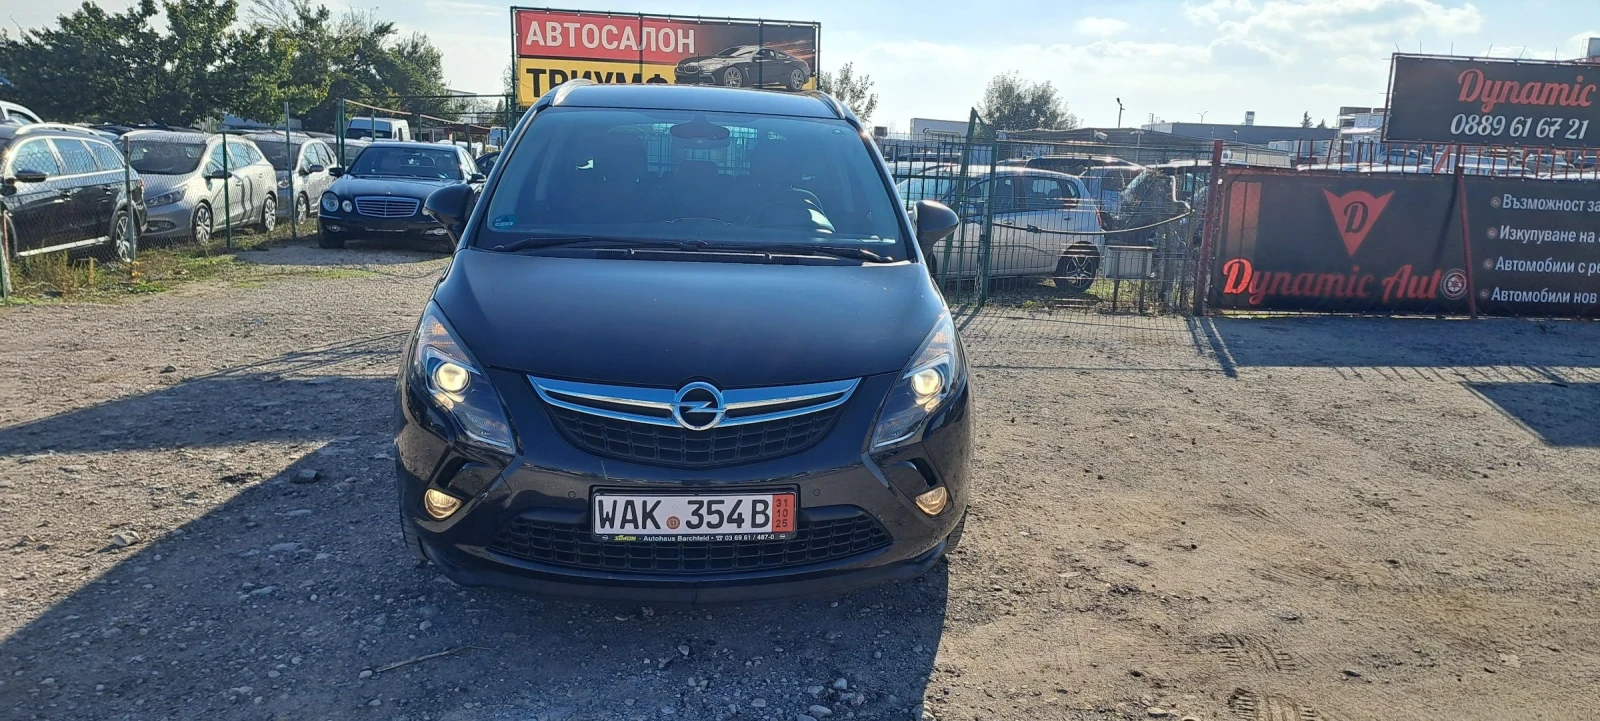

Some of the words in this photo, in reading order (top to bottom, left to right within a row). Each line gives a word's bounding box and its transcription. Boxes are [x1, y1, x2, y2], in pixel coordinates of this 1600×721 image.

[525, 20, 695, 54] АВТОСАЛОН
[1457, 68, 1597, 113] Dynamic
[1450, 113, 1506, 137] 0889
[1509, 116, 1533, 138] 61
[1536, 117, 1564, 139] 67
[1564, 118, 1590, 140] 21
[1502, 193, 1586, 212] Възможност
[1587, 200, 1600, 212] за
[1343, 201, 1369, 234] D
[1499, 224, 1577, 245] Изкупуване
[1579, 230, 1596, 243] на
[1495, 256, 1575, 273] Автомобили
[1578, 262, 1586, 274] с
[1222, 257, 1375, 306] Dynamic
[1491, 286, 1571, 304] Автомобили
[1573, 291, 1598, 304] нов
[775, 498, 788, 508] 31
[597, 499, 662, 530] WAK
[775, 509, 789, 518] 10
[775, 518, 789, 528] 25
[613, 534, 637, 542] SIMON
[677, 534, 710, 542] Barchfeld
